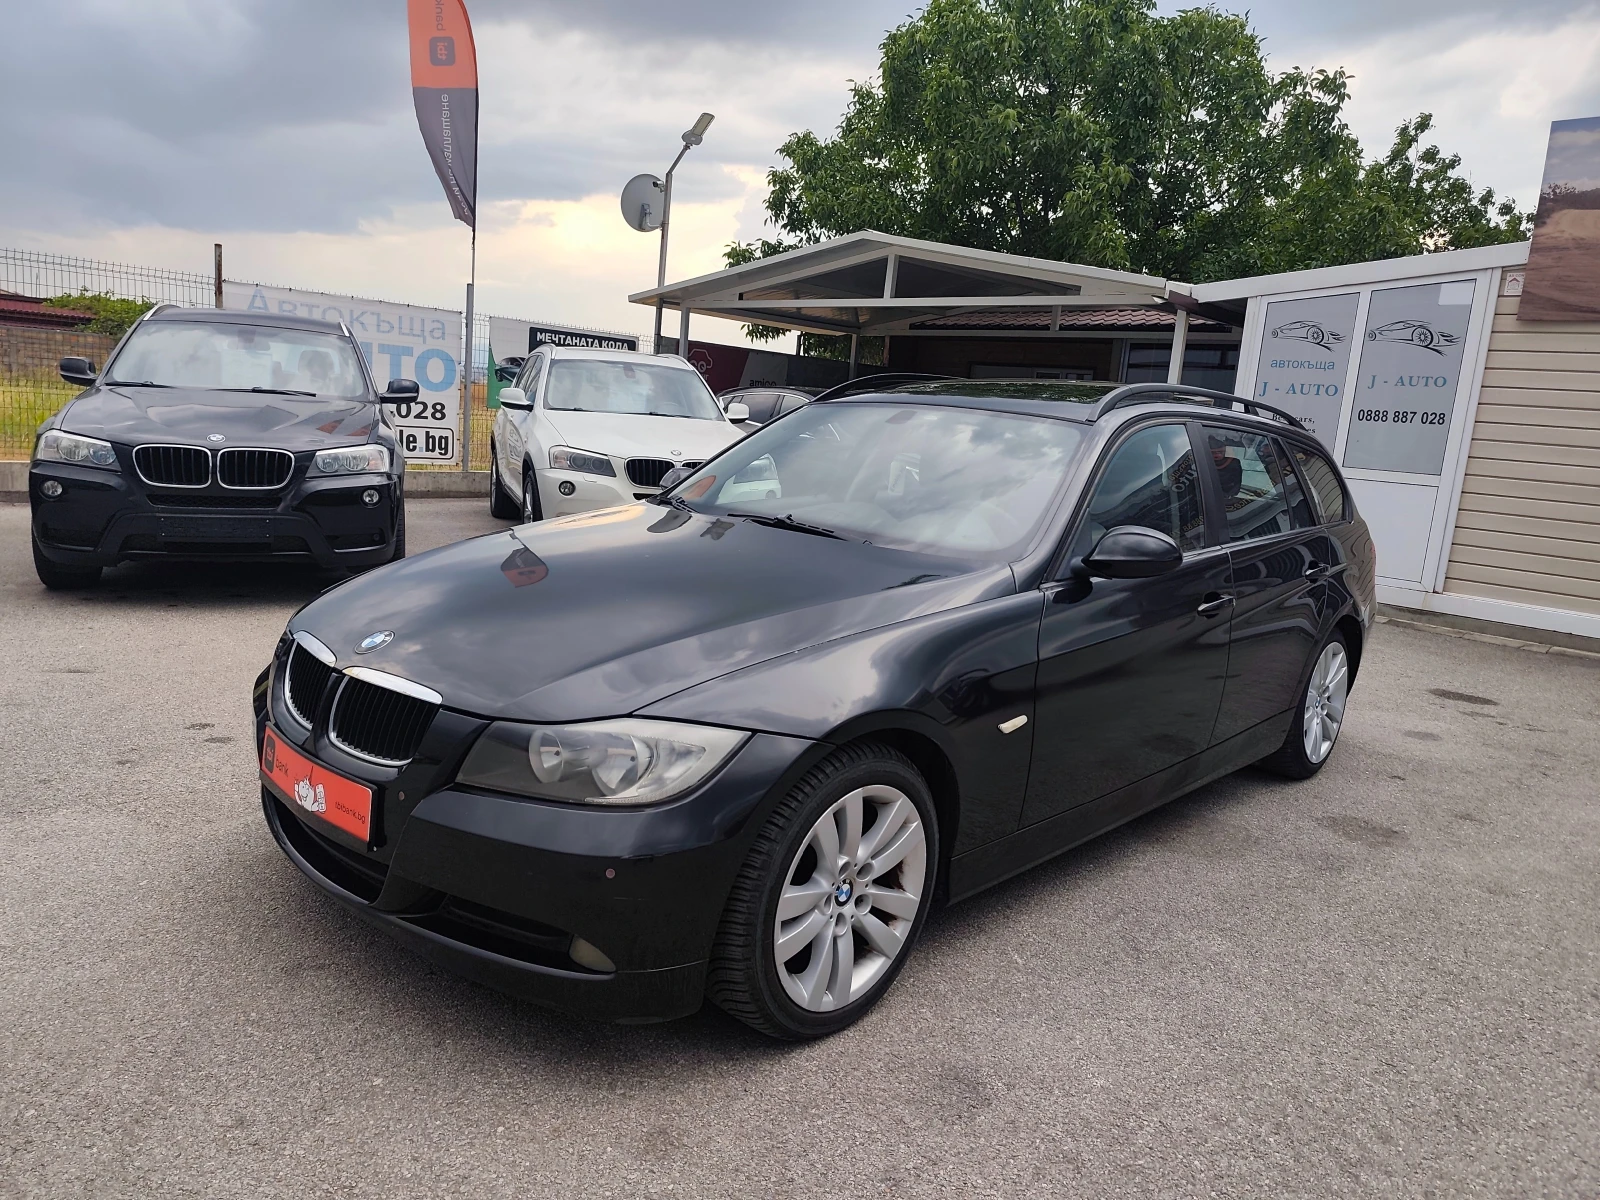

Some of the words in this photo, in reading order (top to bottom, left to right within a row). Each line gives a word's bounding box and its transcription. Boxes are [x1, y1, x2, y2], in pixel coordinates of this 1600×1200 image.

[536, 331, 600, 349] МЕЧТАНАТА
[601, 340, 629, 351] КОЛА
[366, 341, 456, 392] TO
[1270, 358, 1335, 371] автокъща
[1259, 381, 1269, 397] J
[1285, 383, 1339, 397] AUTO
[1367, 374, 1377, 390] J
[1393, 375, 1448, 388] AUTO
[396, 401, 446, 421] 028
[1357, 409, 1389, 423] 0888
[1392, 410, 1417, 424] 887
[1420, 411, 1446, 426] 028
[399, 429, 449, 456] le.bg
